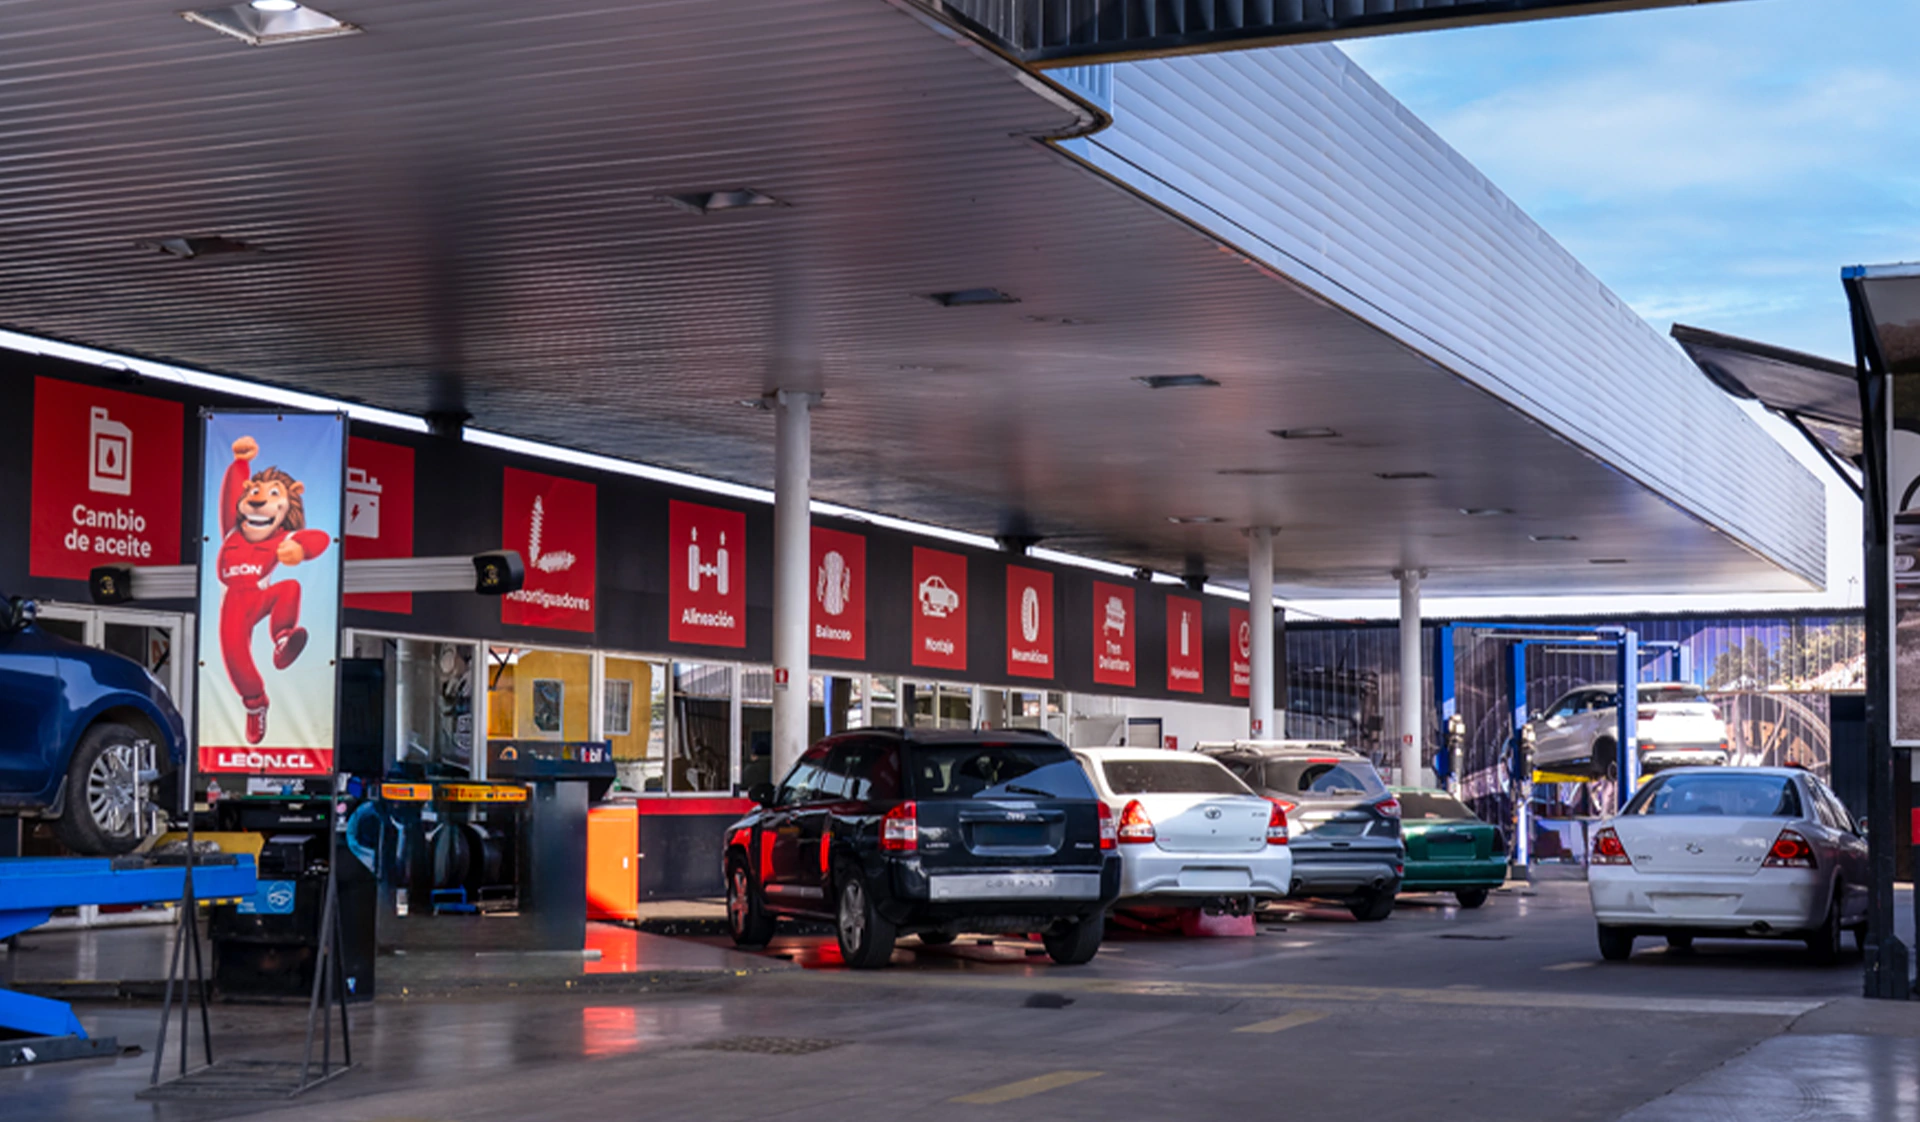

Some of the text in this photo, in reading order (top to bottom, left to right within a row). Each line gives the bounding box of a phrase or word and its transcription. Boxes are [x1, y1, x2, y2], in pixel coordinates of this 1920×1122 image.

[72, 504, 147, 533] Cambio
[64, 528, 152, 558] de aceite
[222, 563, 262, 578] LEON
[682, 607, 735, 629] Alineación
[815, 624, 852, 642] Balanceo
[925, 637, 955, 655] Montaje
[1106, 640, 1122, 655] Tren
[1011, 648, 1049, 664] Neumáticos
[1099, 655, 1131, 672] Delantero
[218, 752, 314, 768] LEON.CL
